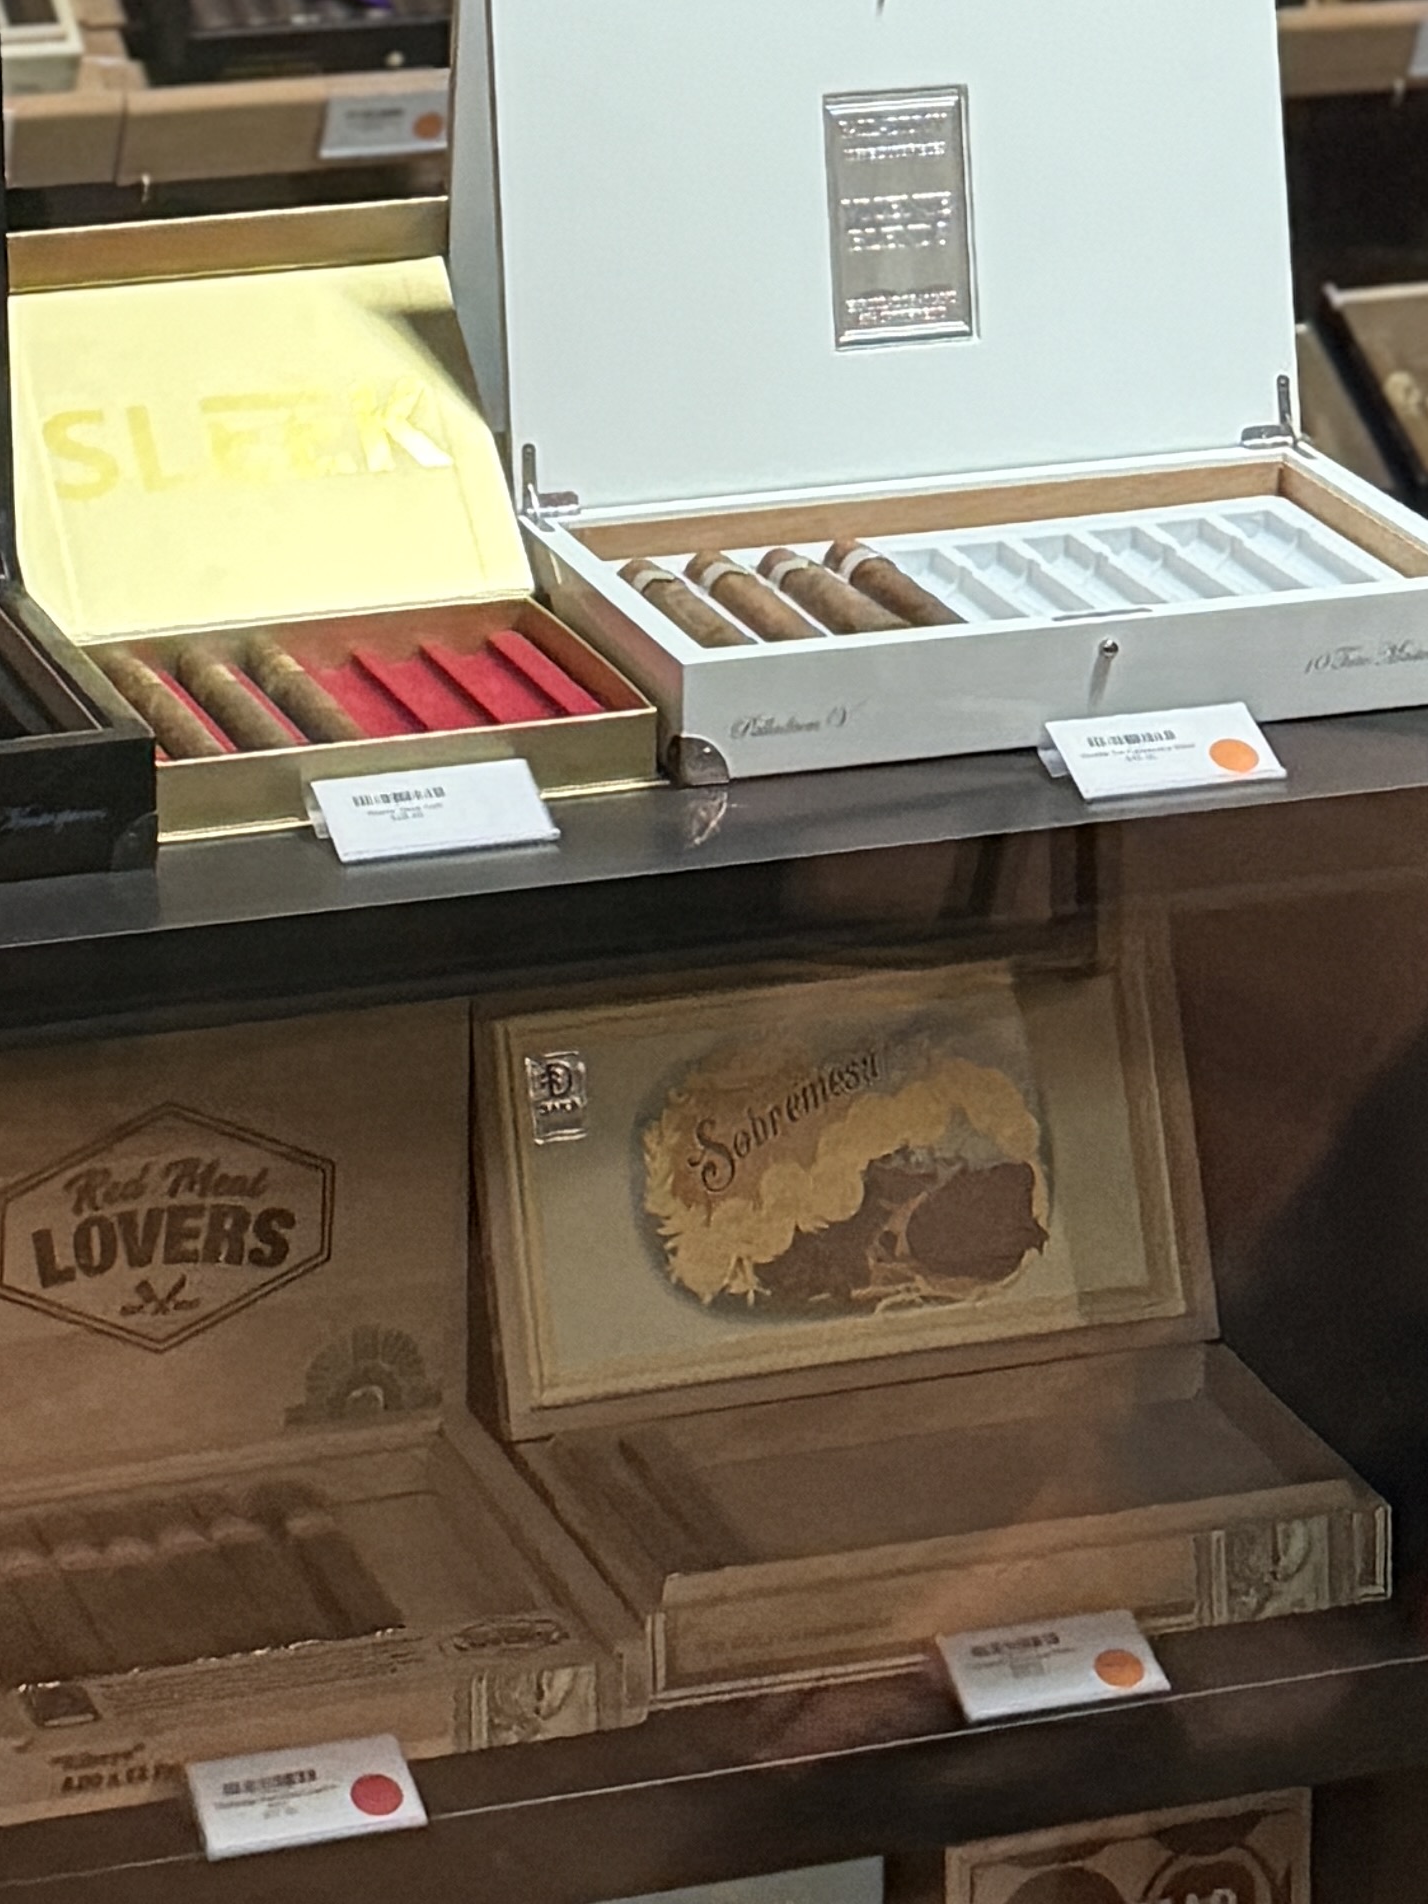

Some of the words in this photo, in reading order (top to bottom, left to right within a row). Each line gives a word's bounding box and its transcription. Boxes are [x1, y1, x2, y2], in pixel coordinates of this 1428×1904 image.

[686, 1048, 882, 1194] Sobremesa
[62, 1162, 149, 1215] Red
[158, 1155, 269, 1202] Meat
[31, 1206, 298, 1289] LOVERS
